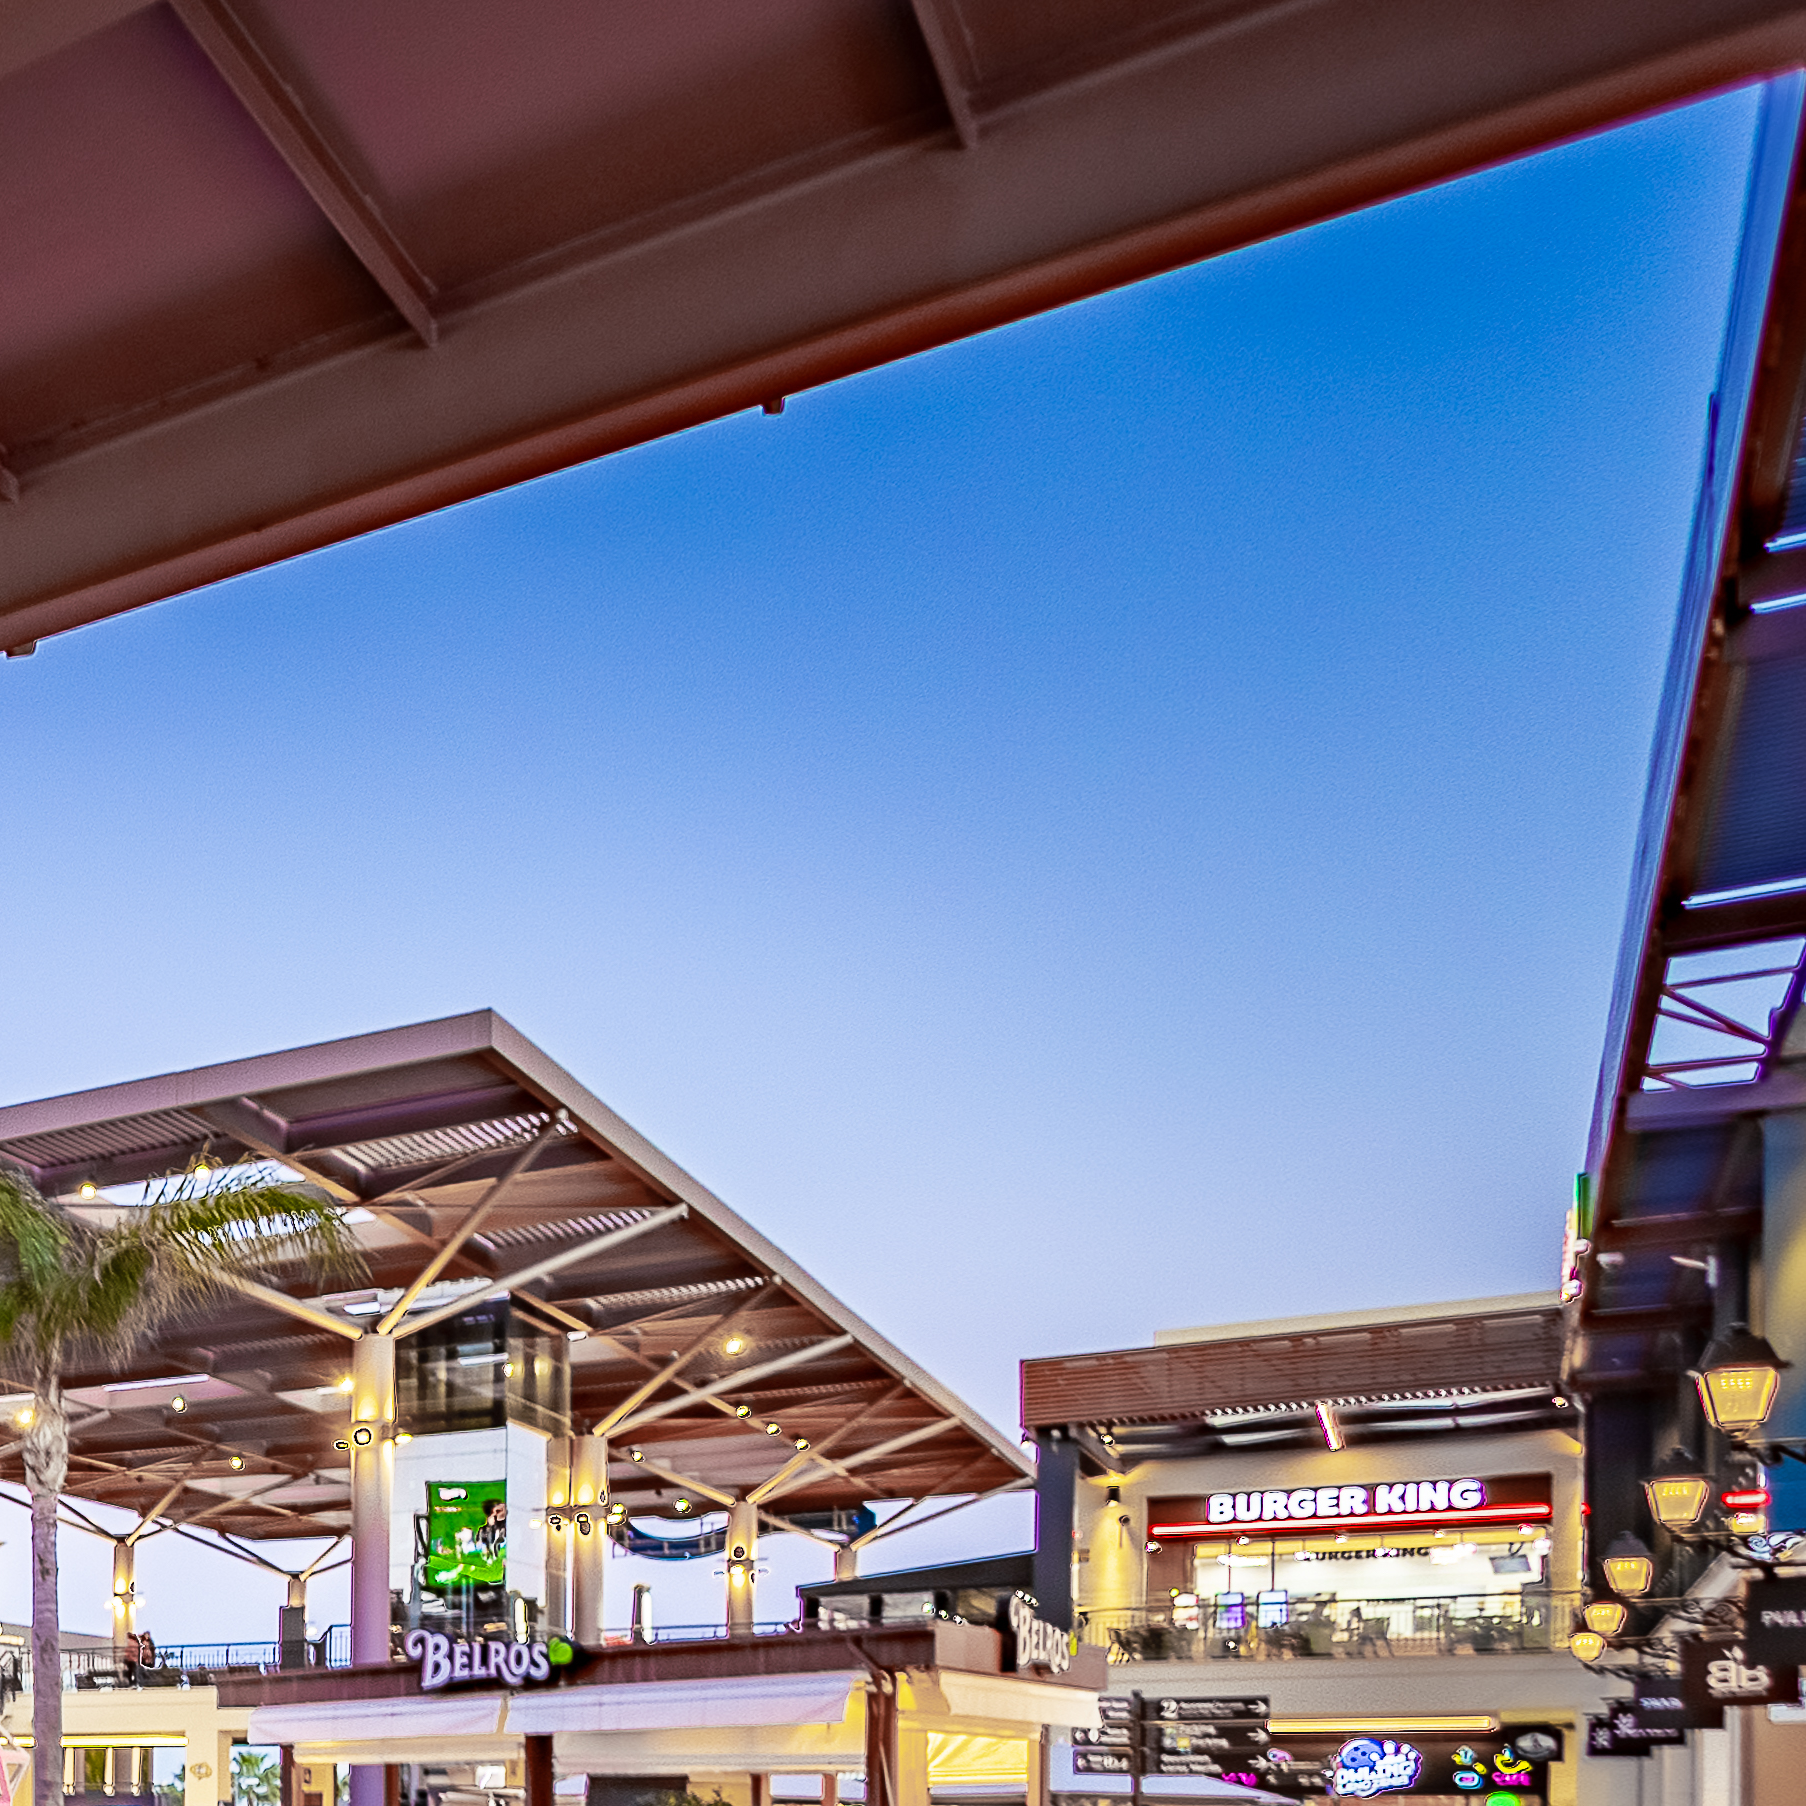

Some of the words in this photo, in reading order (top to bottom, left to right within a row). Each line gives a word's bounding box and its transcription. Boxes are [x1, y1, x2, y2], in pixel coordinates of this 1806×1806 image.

[1207, 1486, 1368, 1523] BURGER
[1374, 1478, 1487, 1514] KING
[405, 1629, 550, 1690] BELROS
